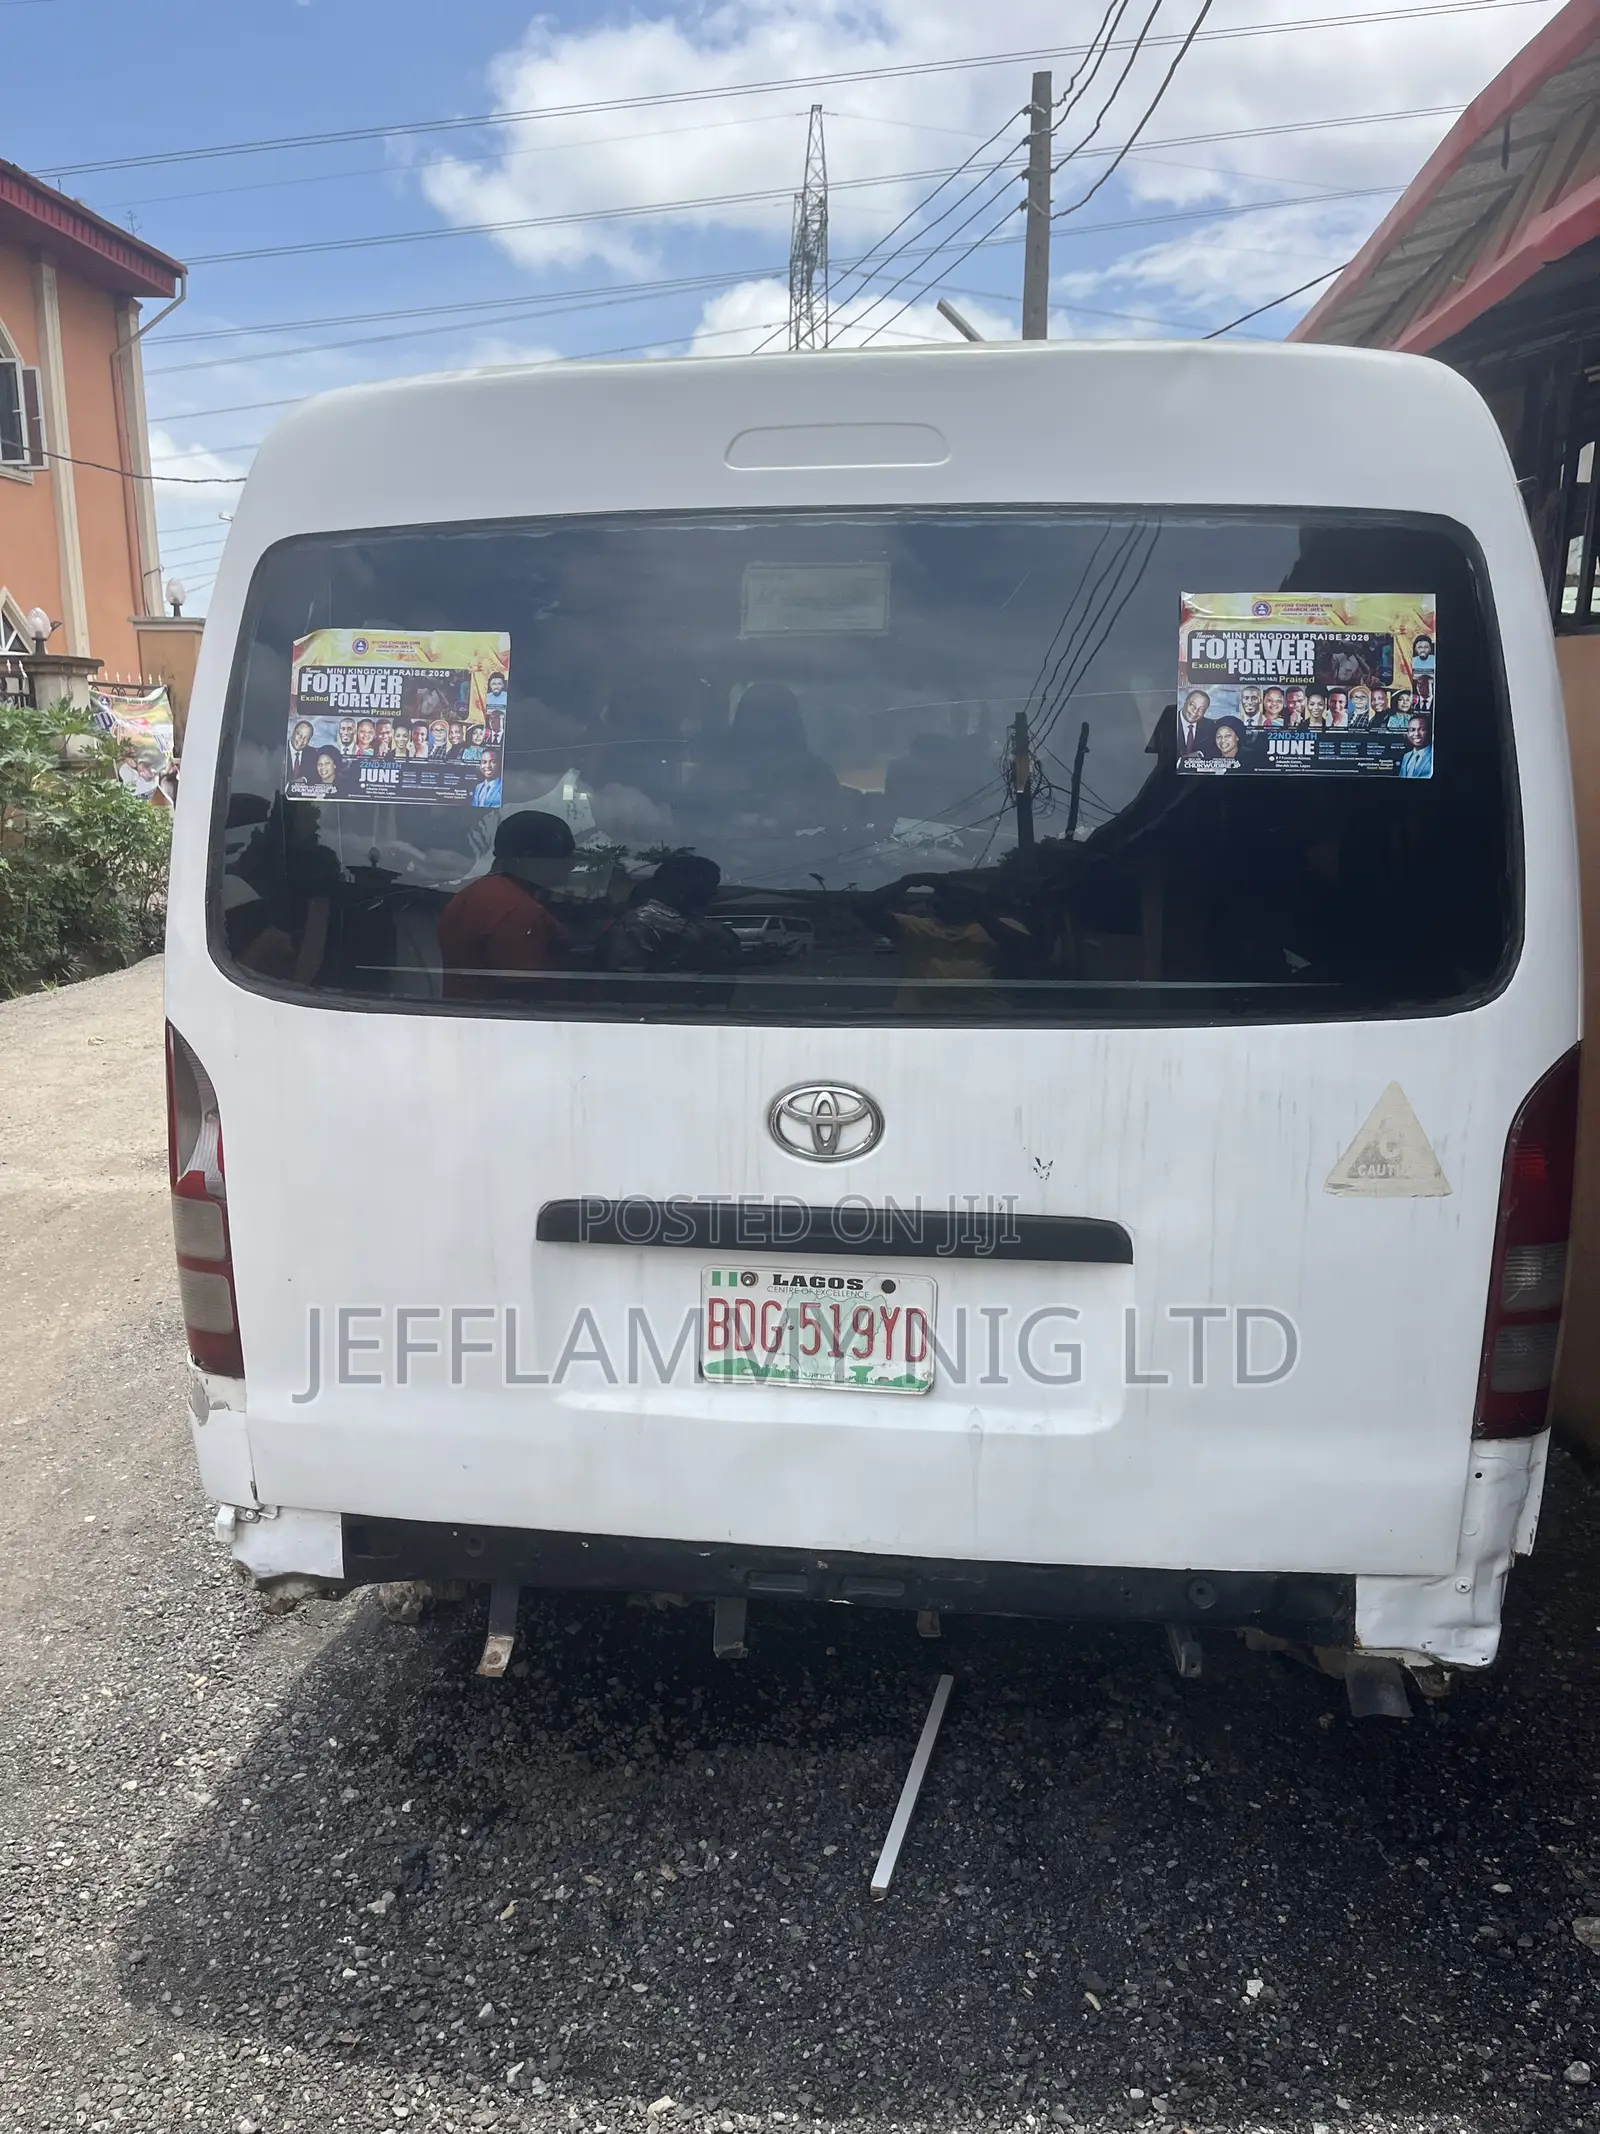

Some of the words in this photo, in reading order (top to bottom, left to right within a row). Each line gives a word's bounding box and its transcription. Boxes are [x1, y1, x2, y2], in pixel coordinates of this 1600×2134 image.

[1222, 632, 1246, 640] MINI
[1249, 632, 1300, 641] KINGDOM
[1303, 633, 1342, 641] PRAISE
[1191, 638, 1315, 660] FOREVER
[326, 667, 346, 675] MINI
[349, 668, 391, 676] KINGDOM
[393, 669, 427, 677] PRAISE
[1191, 661, 1227, 669] Exalted
[1228, 659, 1314, 675] FOREVER
[301, 673, 403, 695] FOREVER
[1279, 676, 1316, 684] Praised
[300, 694, 329, 702] Exalted
[329, 692, 401, 709] FOREVER
[371, 708, 402, 717] Praised
[1267, 732, 1318, 740] 22ND-28TH
[1267, 739, 1315, 755] JUNE
[359, 768, 400, 784] JUNE
[772, 1273, 864, 1291] LAGOS
[766, 1285, 799, 1295] CENTRE
[800, 1287, 814, 1296] OF
[816, 1287, 870, 1299] EXCELLENCE
